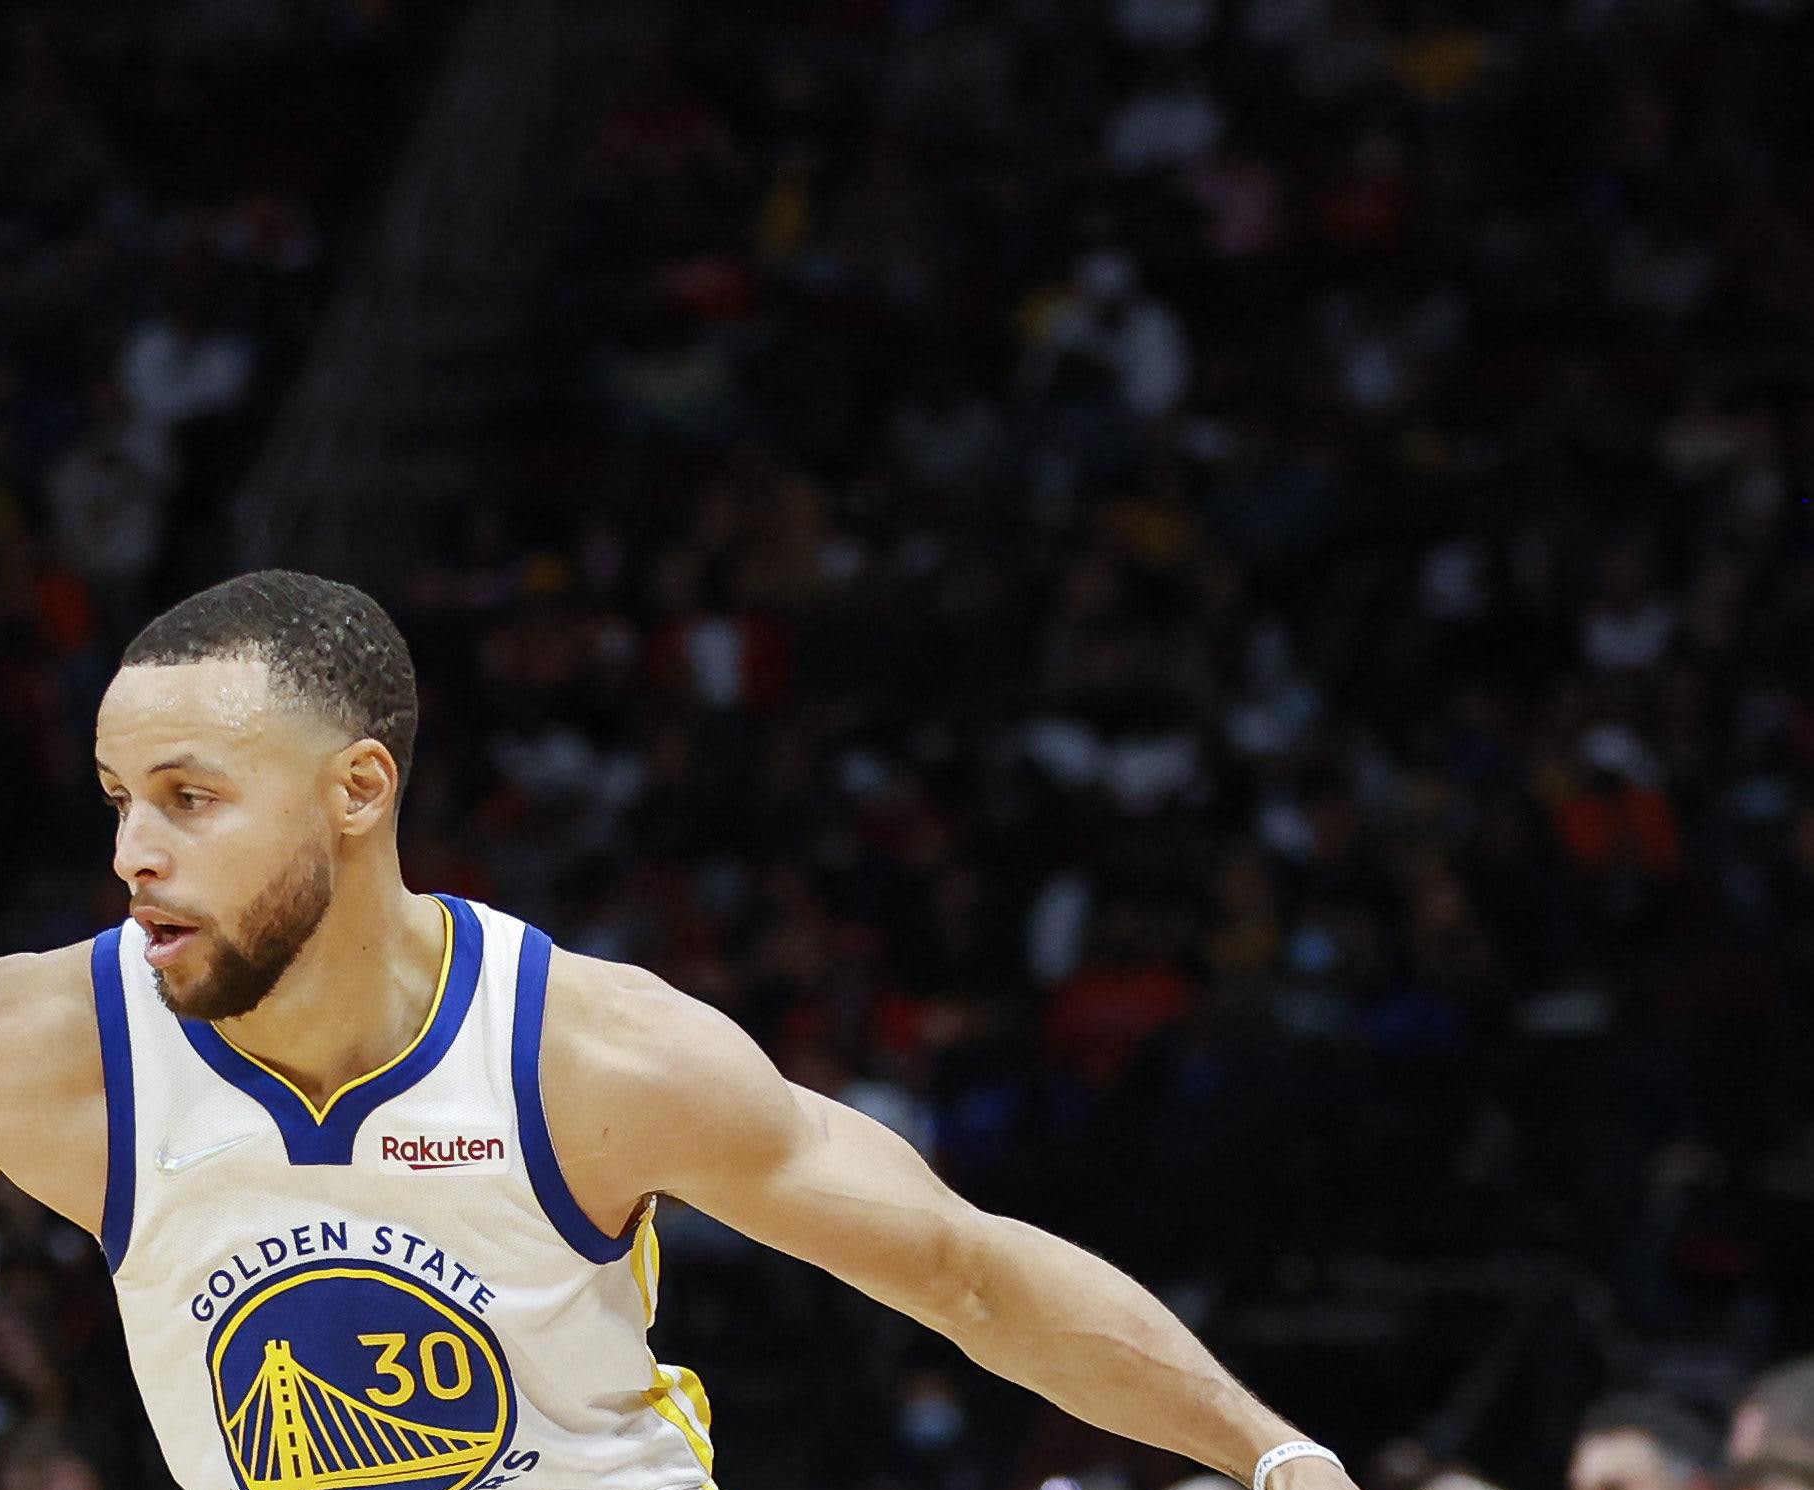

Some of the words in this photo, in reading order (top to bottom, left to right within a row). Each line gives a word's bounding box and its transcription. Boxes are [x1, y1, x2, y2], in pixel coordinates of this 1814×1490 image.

[381, 1135, 504, 1162] Rakuten
[191, 1221, 350, 1324] GOLDEN
[371, 1225, 497, 1316] STATE
[357, 1331, 474, 1408] 30
